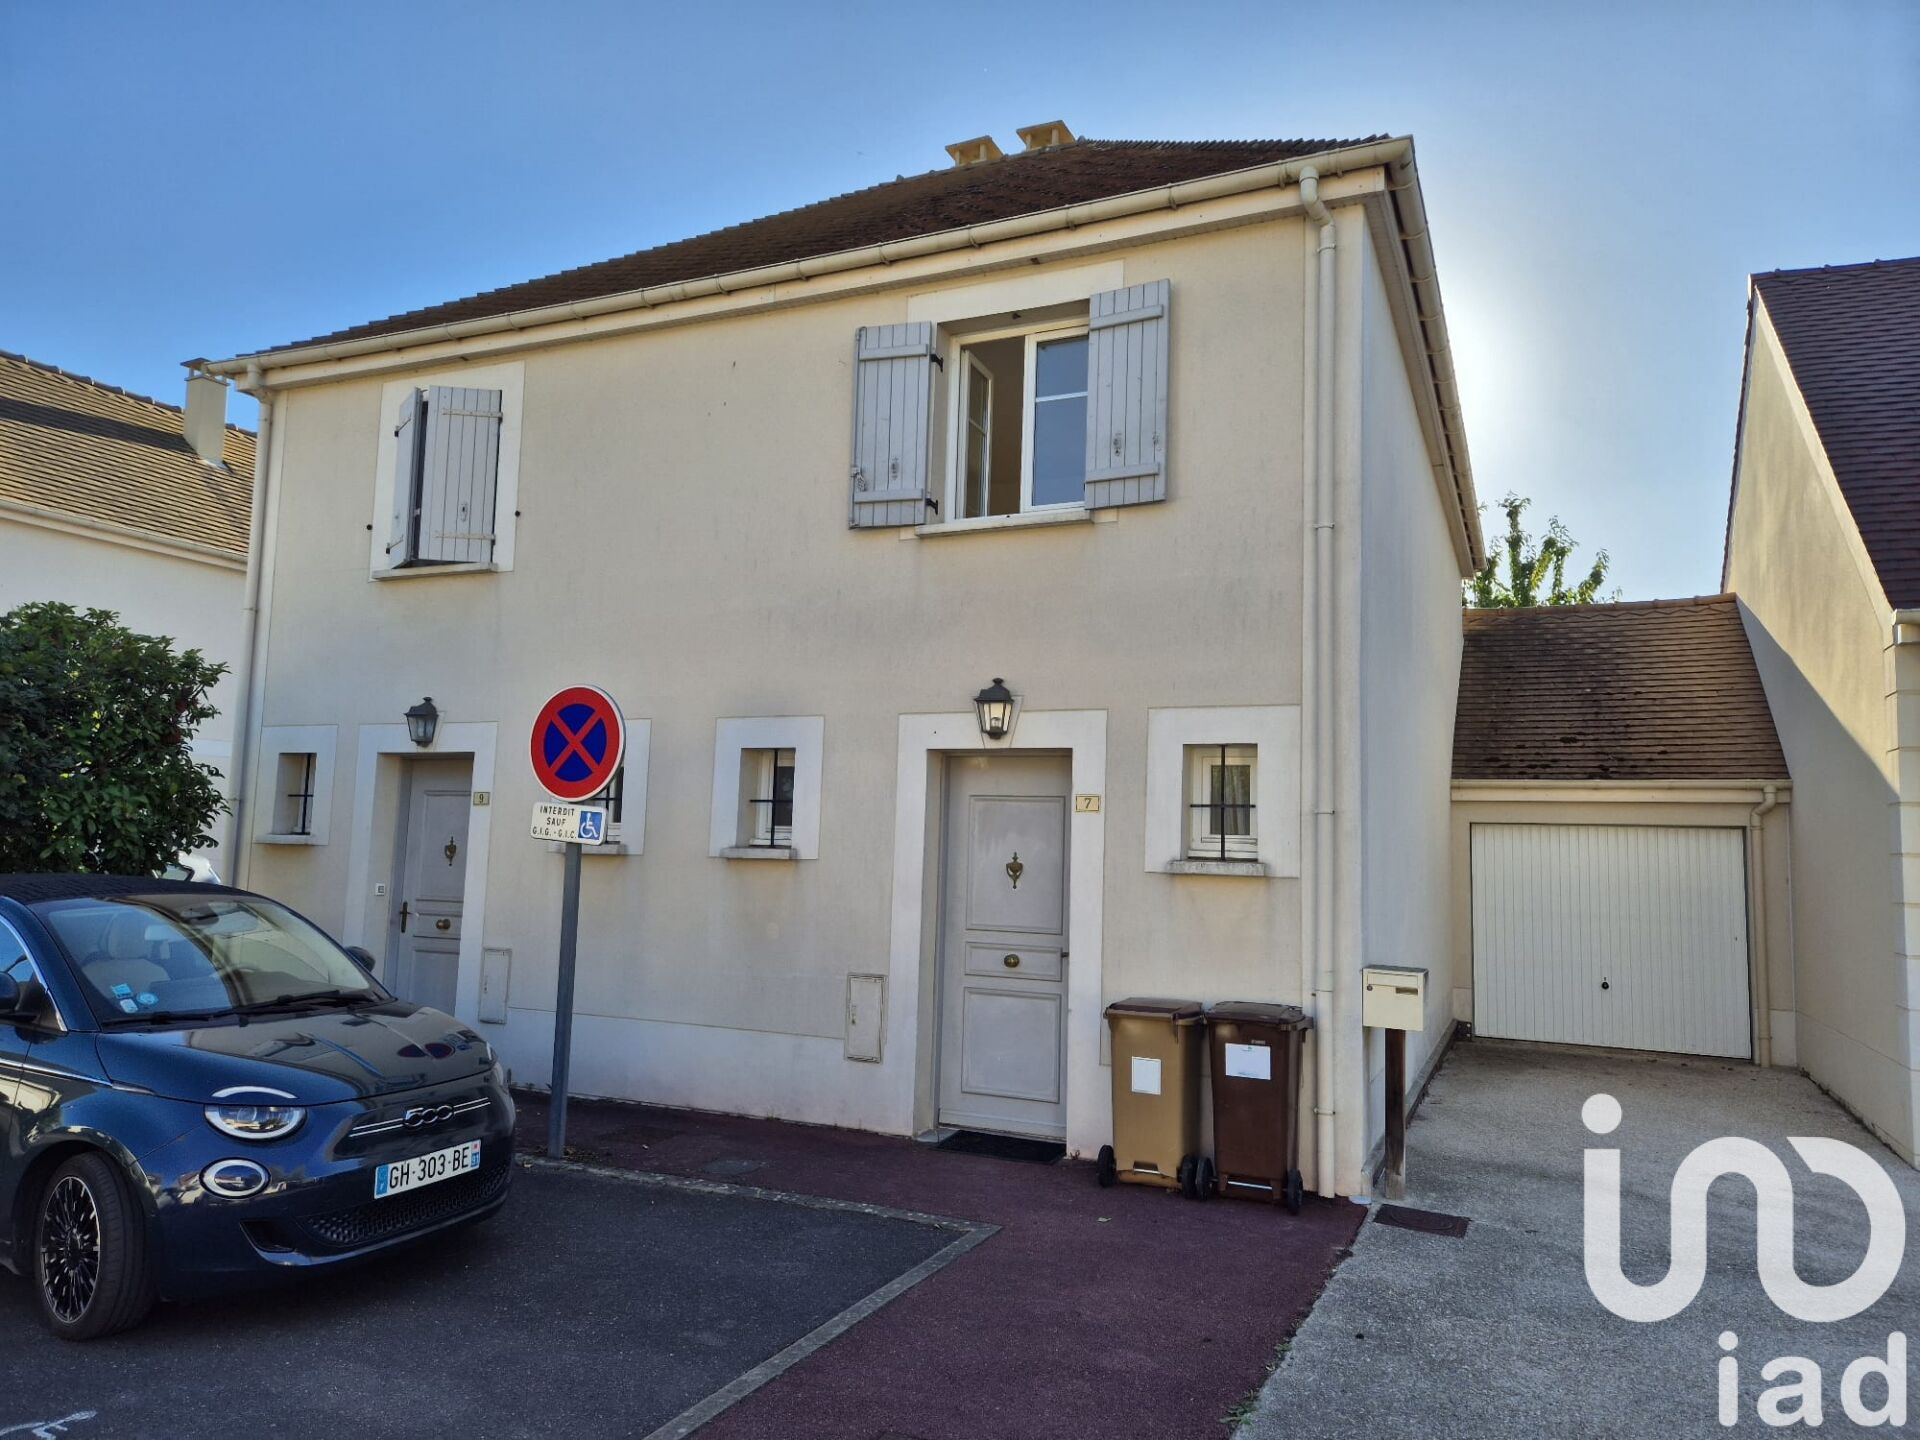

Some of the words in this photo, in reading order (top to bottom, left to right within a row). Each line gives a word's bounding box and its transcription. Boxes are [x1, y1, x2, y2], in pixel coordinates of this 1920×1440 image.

[1084, 797, 1093, 809] 7
[539, 805, 575, 817] INTERDIT
[546, 817, 567, 827] SAUF
[404, 1105, 453, 1127] 500
